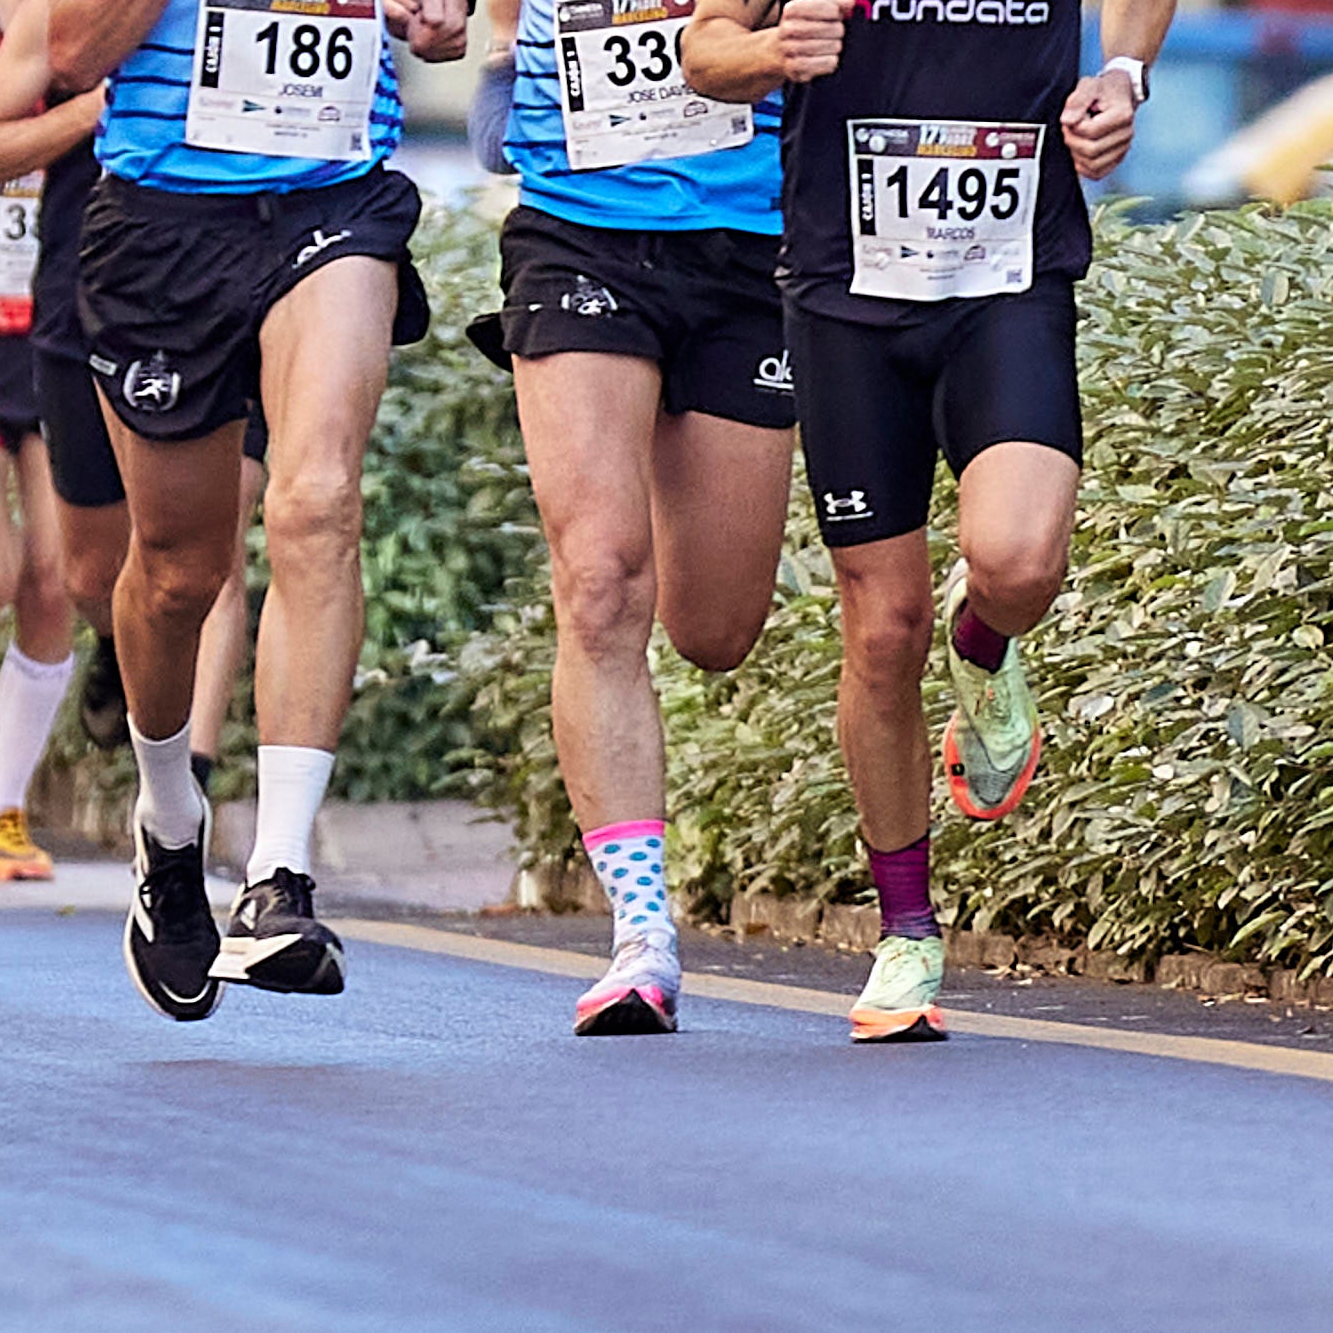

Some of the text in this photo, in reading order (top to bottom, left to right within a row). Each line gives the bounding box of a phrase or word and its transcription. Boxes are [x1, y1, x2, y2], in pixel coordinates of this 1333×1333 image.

[255, 21, 354, 80] 186
[603, 25, 684, 86] 33
[886, 165, 1020, 220] 1495
